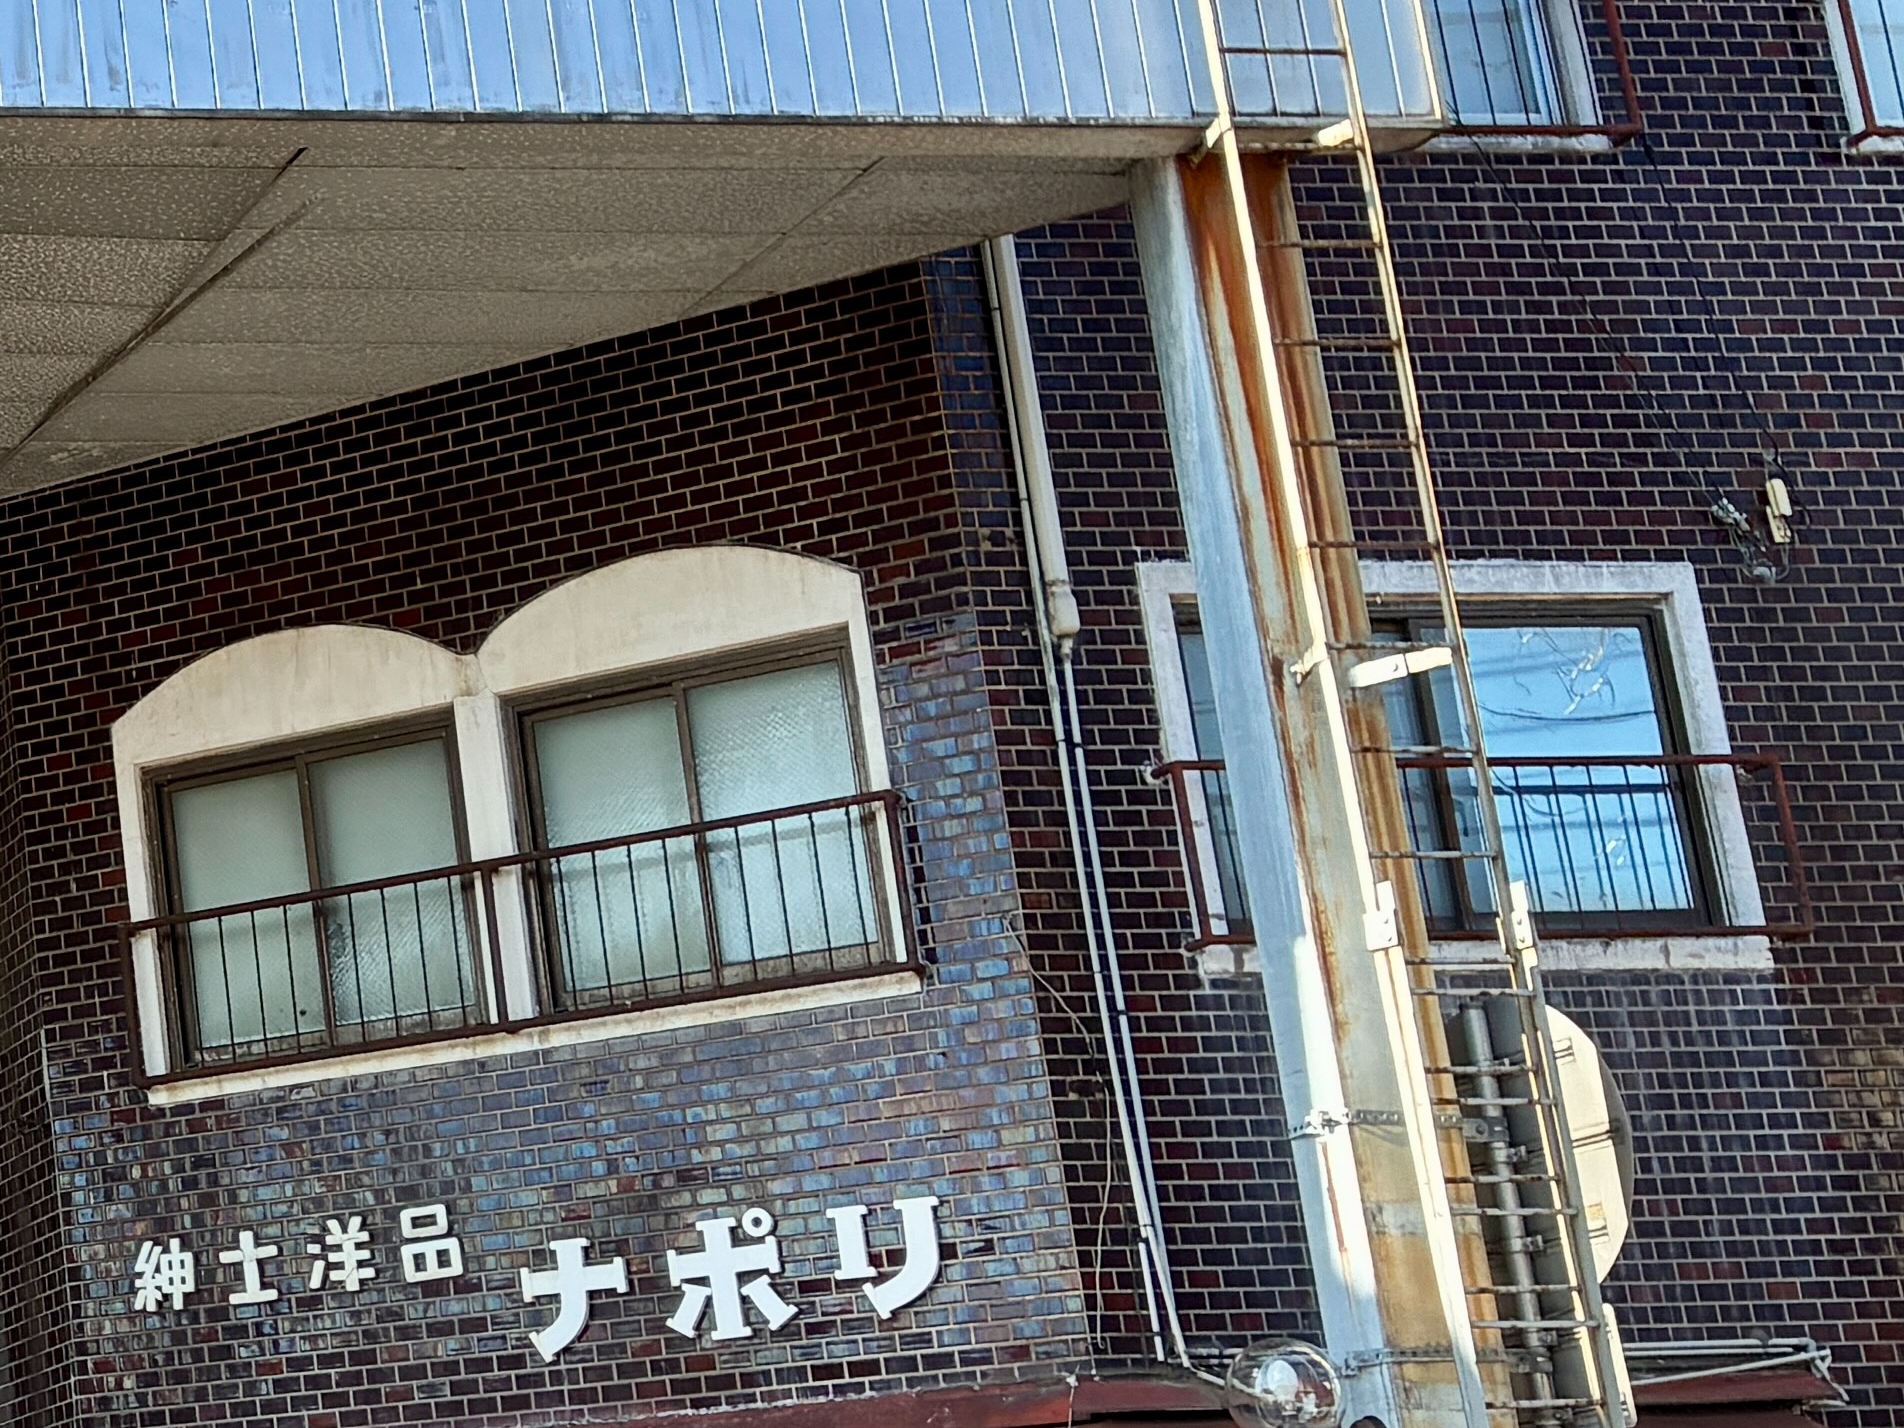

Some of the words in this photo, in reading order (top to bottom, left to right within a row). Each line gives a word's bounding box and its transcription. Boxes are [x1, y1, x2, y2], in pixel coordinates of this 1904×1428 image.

[134, 1203, 464, 1313] 紳士洋品
[520, 1195, 941, 1363] ナポリ
